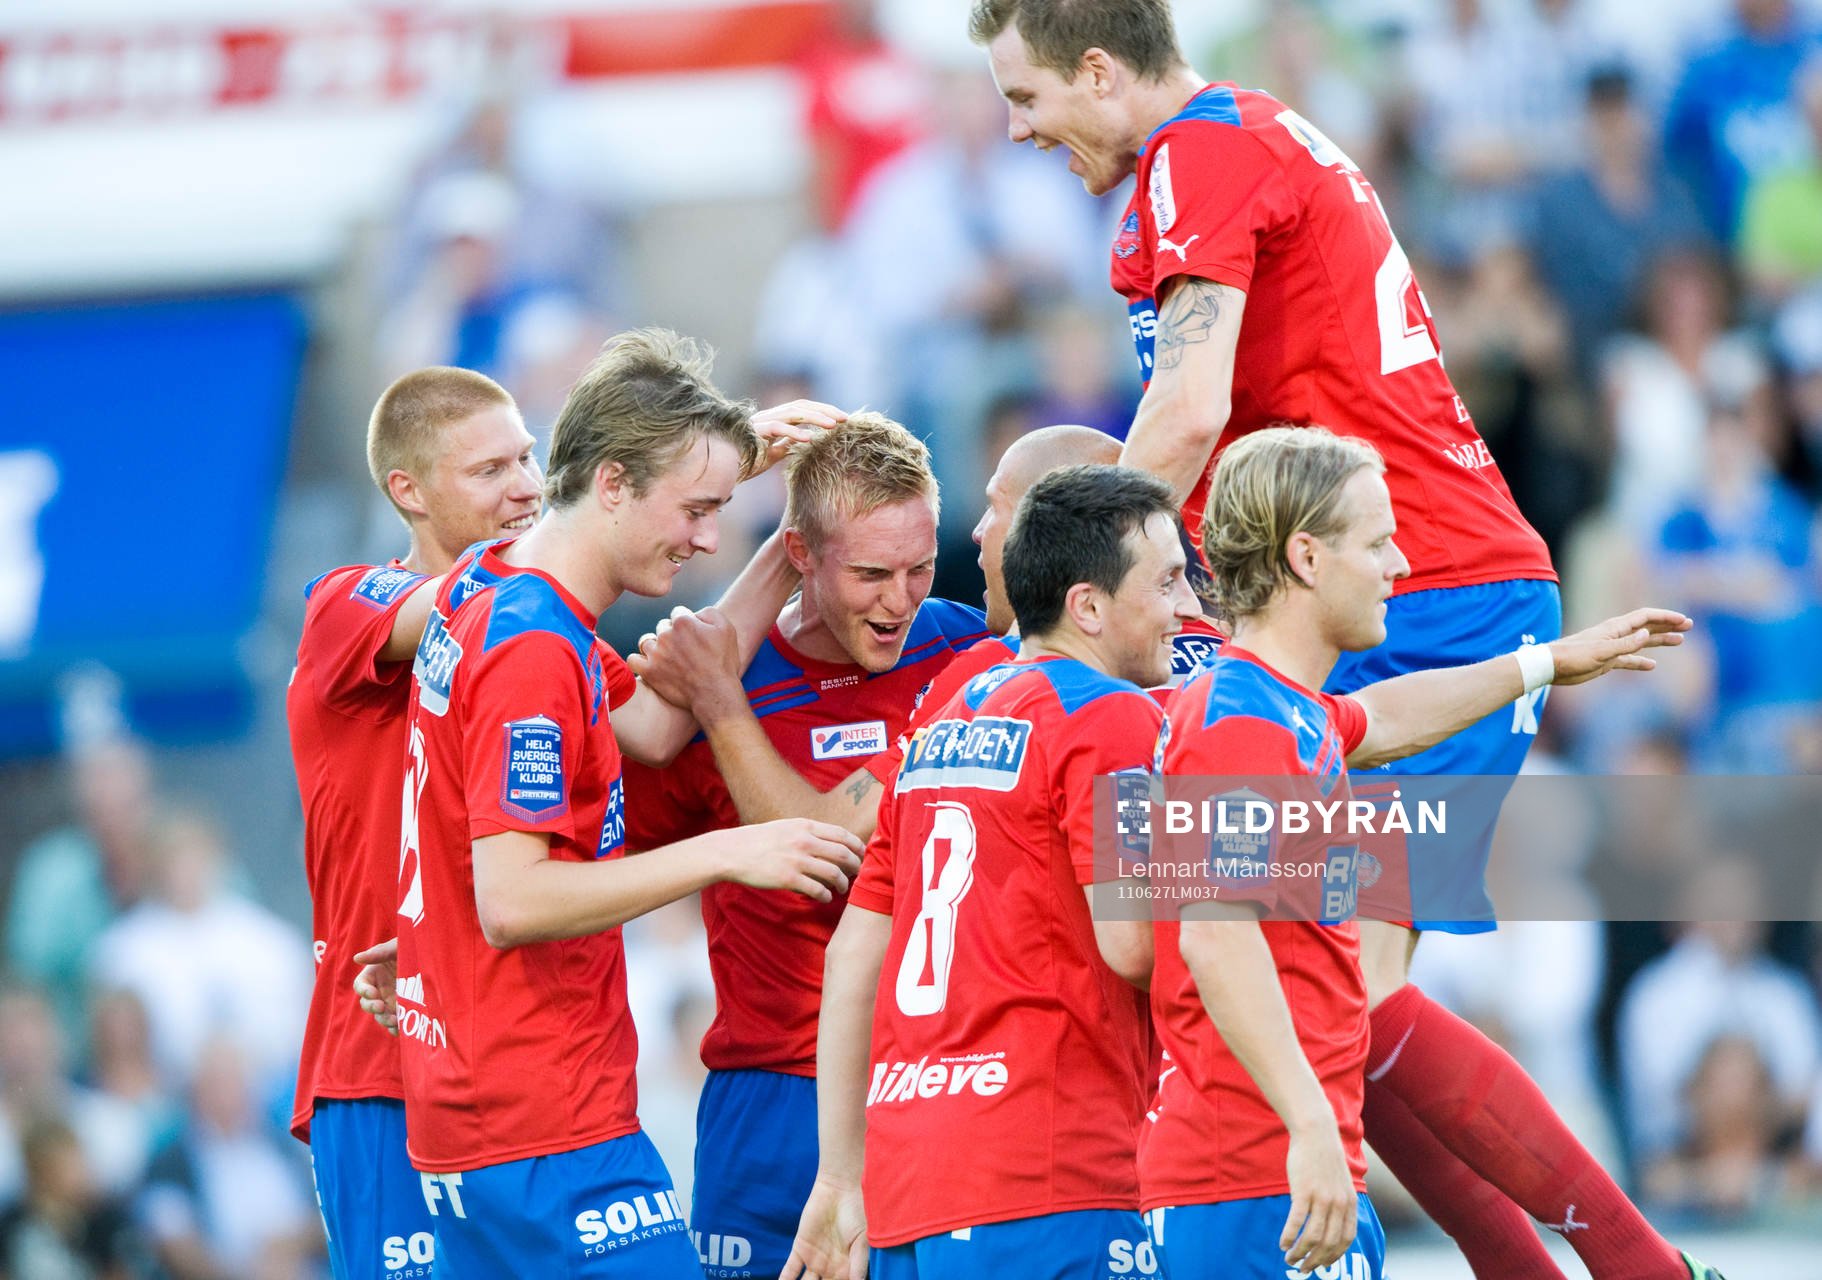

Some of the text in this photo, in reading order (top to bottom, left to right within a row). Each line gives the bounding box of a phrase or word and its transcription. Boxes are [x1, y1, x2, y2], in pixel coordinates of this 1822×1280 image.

[841, 727, 878, 740] INTER
[525, 740, 552, 750] HELA
[843, 739, 879, 751] SPORT
[513, 750, 560, 764] SVERIGES
[511, 761, 561, 774] FOTBOLLS
[519, 773, 554, 784] KLUBB
[896, 801, 977, 1017] 8
[688, 1228, 752, 1268] LID
